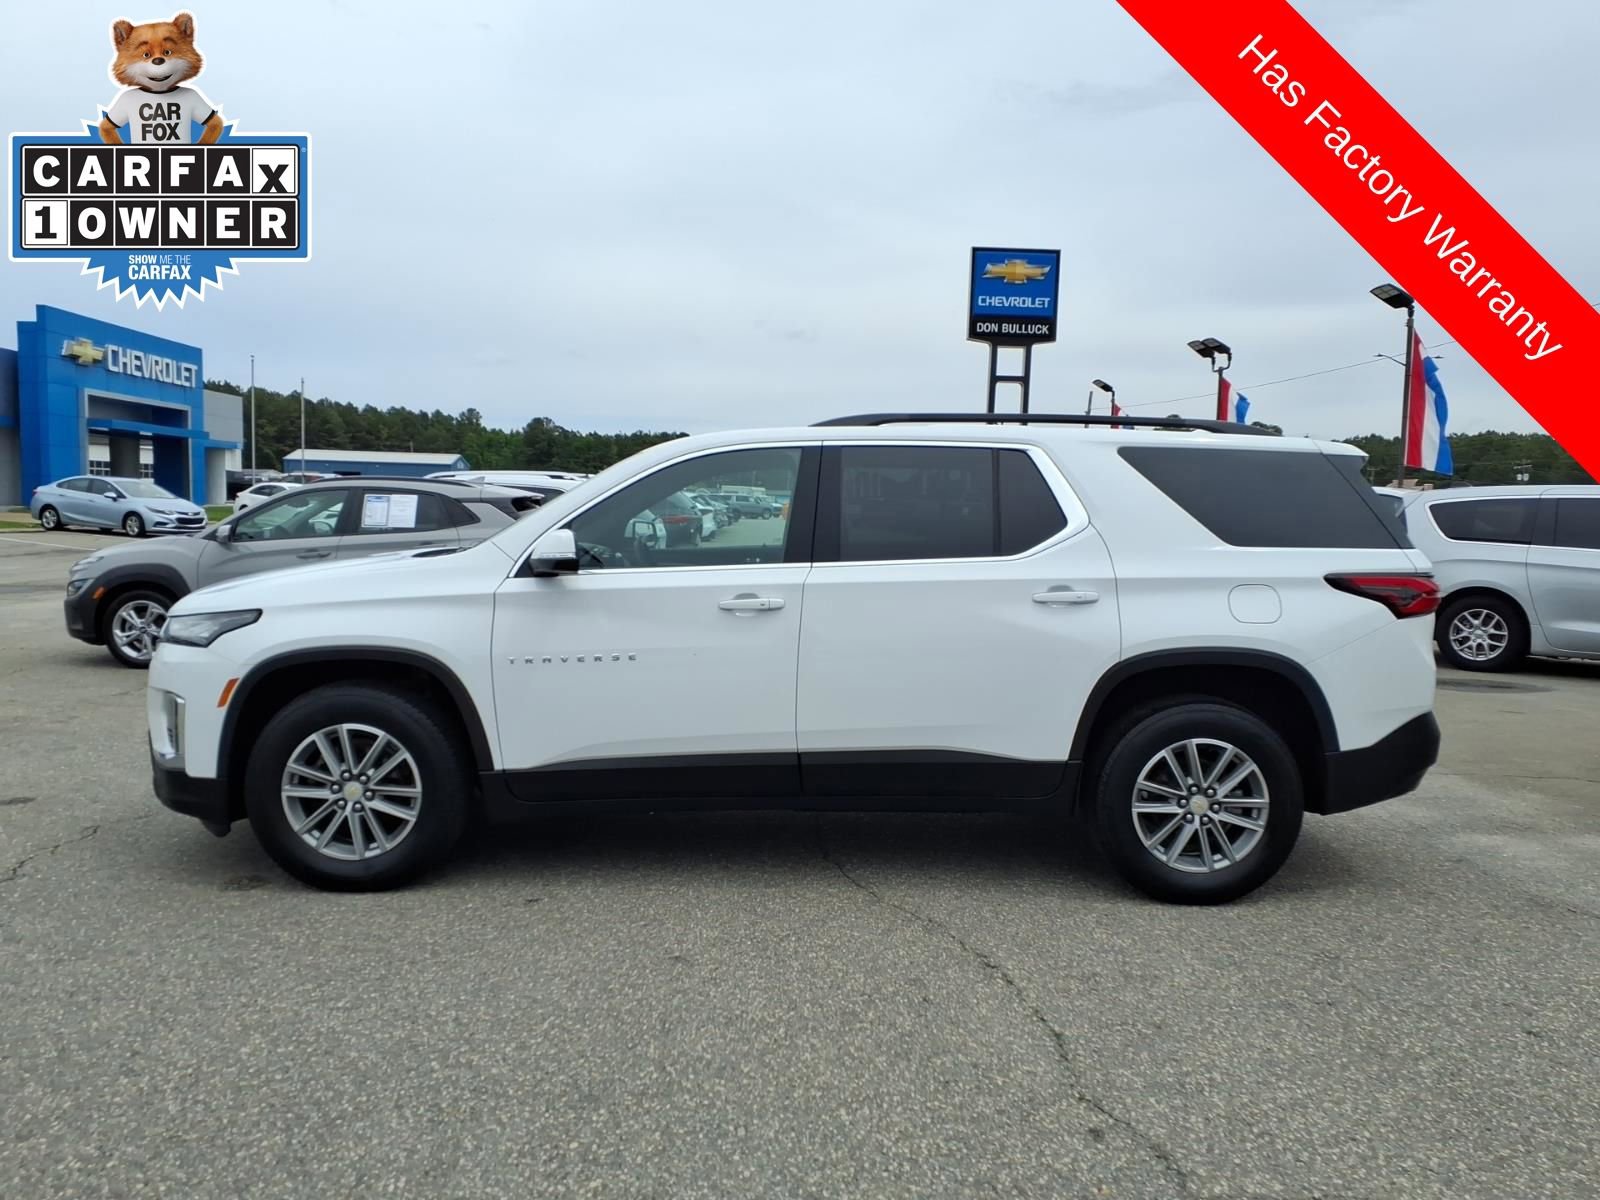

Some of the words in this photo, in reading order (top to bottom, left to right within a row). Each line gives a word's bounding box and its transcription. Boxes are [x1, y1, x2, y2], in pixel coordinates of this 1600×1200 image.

[978, 296, 1051, 308] CHEVROLET
[976, 322, 998, 333] DON
[1001, 323, 1049, 334] BULLUCK
[105, 344, 198, 388] CHEVROLET
[507, 653, 637, 665] TRAVERSE
